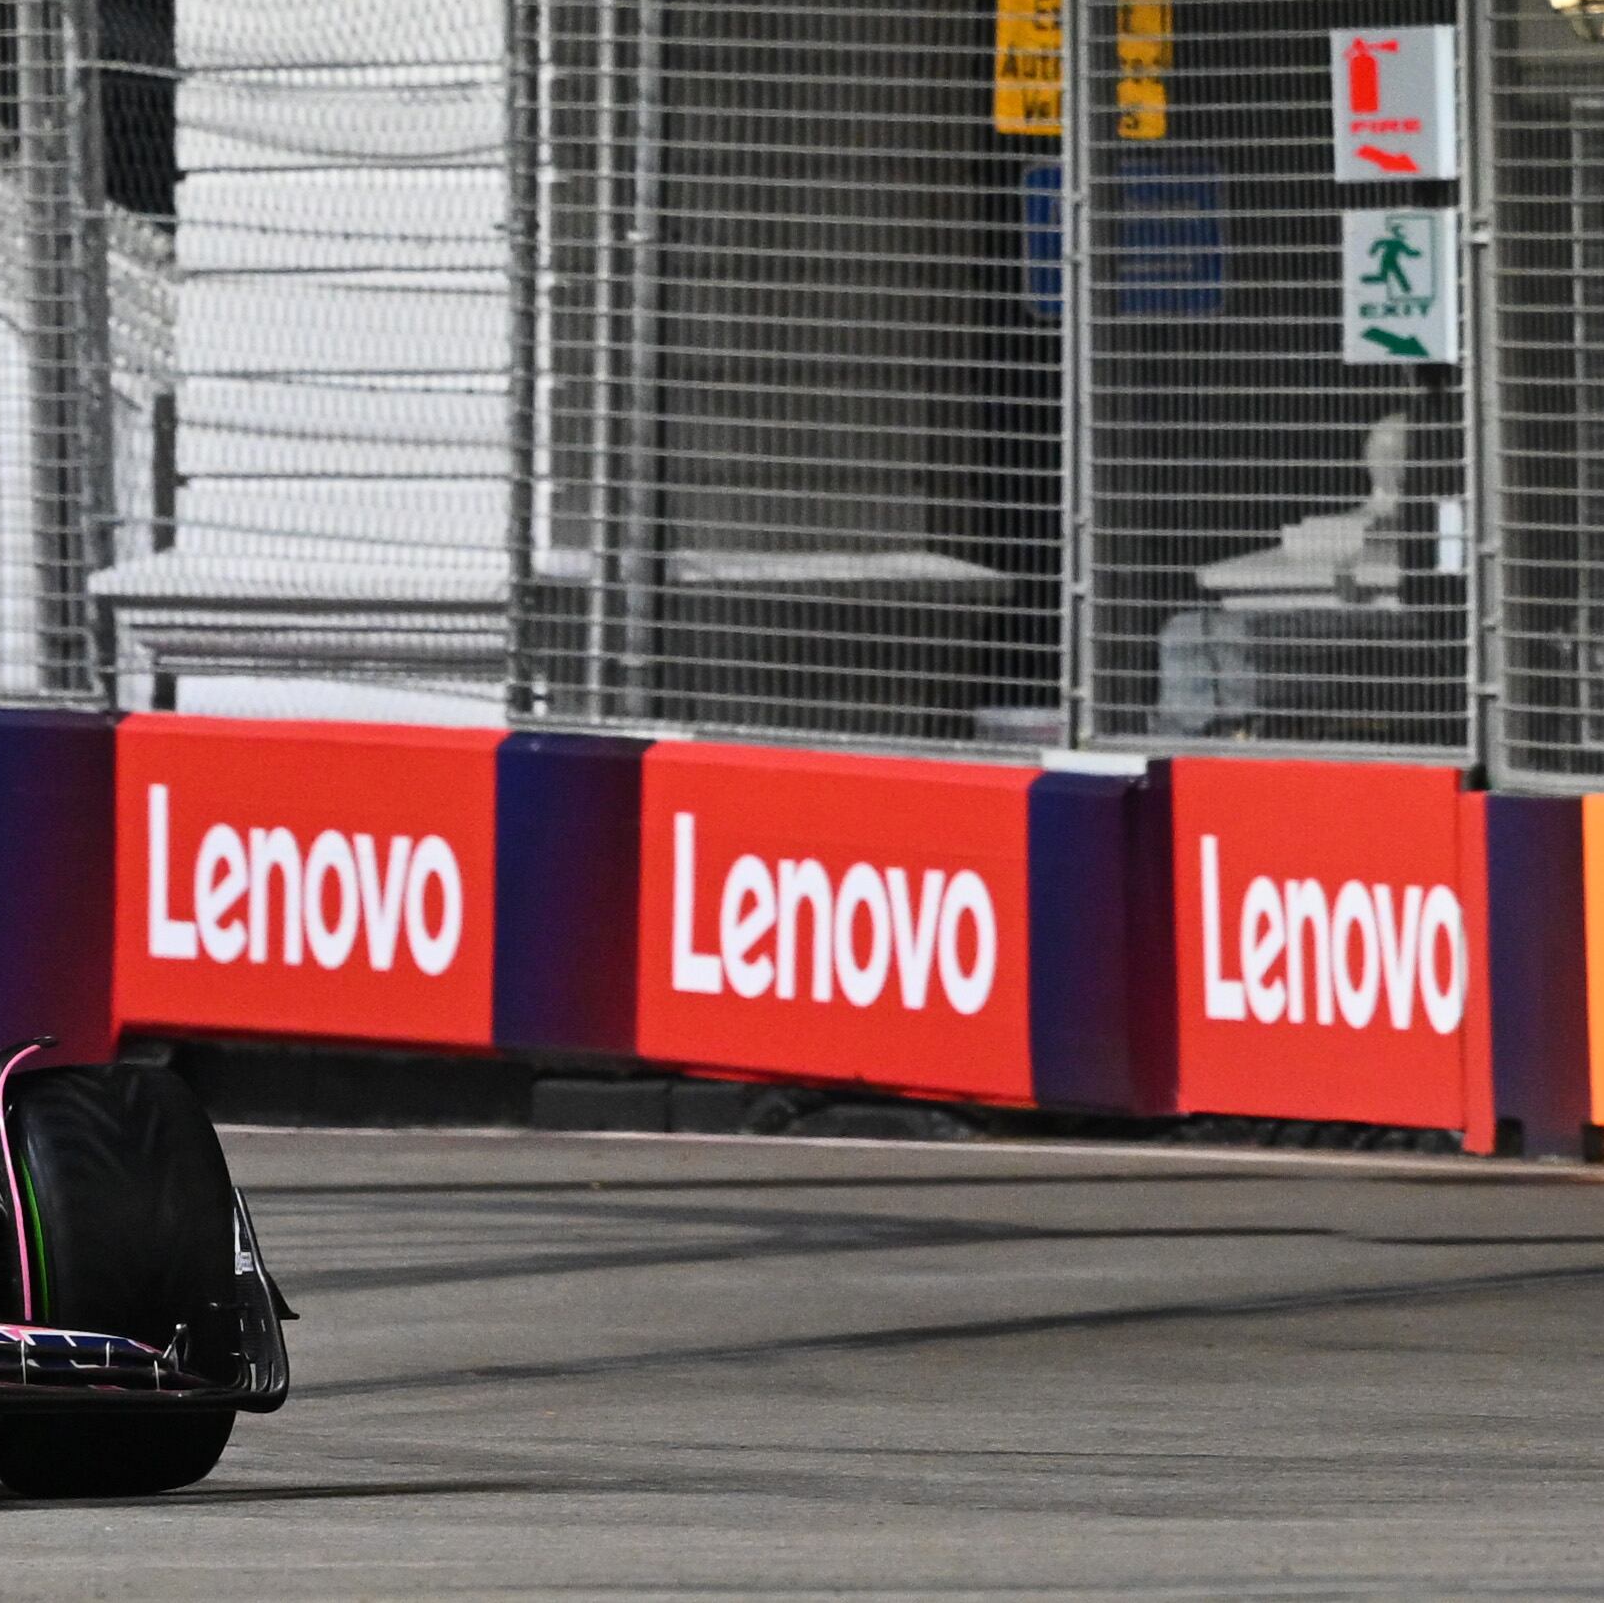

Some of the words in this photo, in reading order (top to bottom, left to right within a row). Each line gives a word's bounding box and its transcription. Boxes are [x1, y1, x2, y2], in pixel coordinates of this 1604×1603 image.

[1359, 301, 1432, 318] EXIT
[147, 782, 464, 977] Lenovo
[672, 811, 998, 1015] Lenovo
[1199, 833, 1470, 1036] Lenovo
